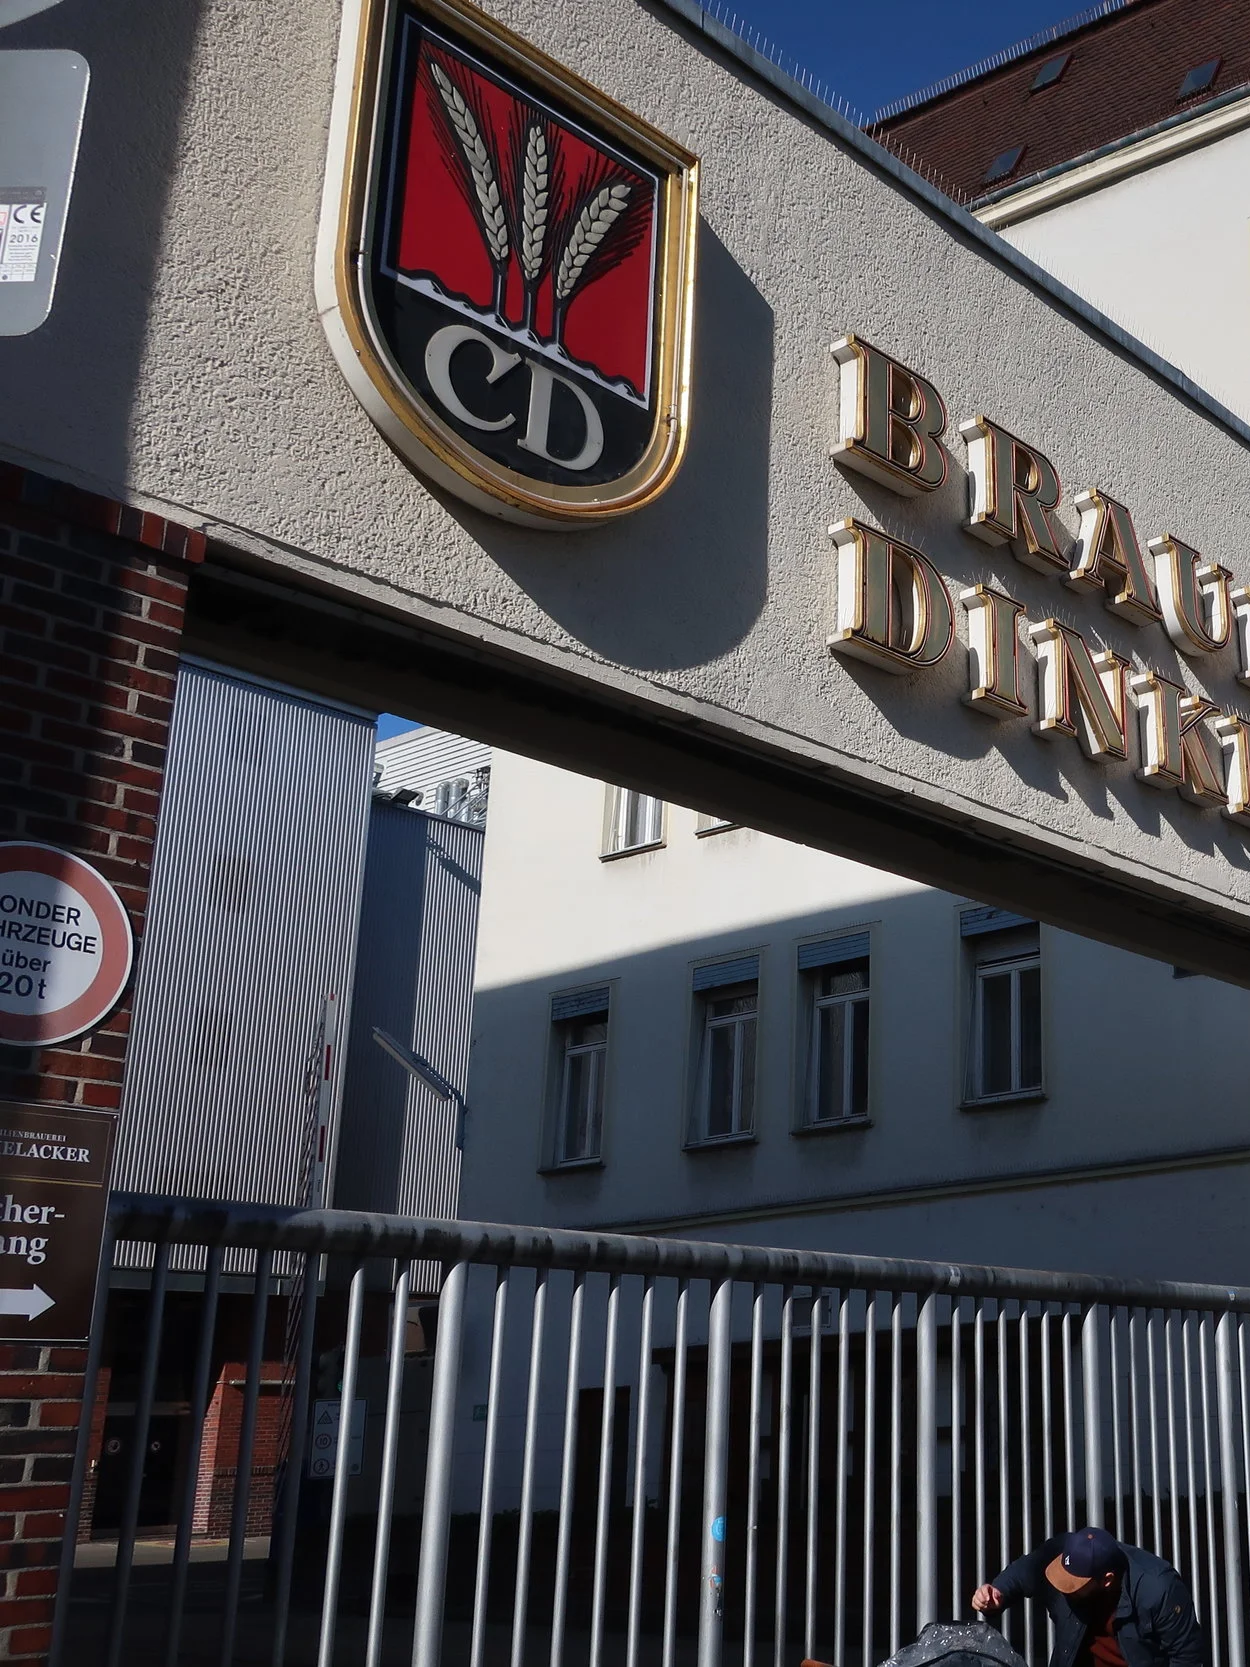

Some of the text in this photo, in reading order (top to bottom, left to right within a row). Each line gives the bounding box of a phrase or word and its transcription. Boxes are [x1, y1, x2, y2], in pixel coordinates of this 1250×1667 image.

[9, 233, 38, 243] 2016
[424, 324, 604, 471] CD
[0, 894, 81, 927] ONDER
[2, 949, 51, 973] über
[0, 971, 33, 997] 20
[0, 1140, 91, 1163] ELACKER
